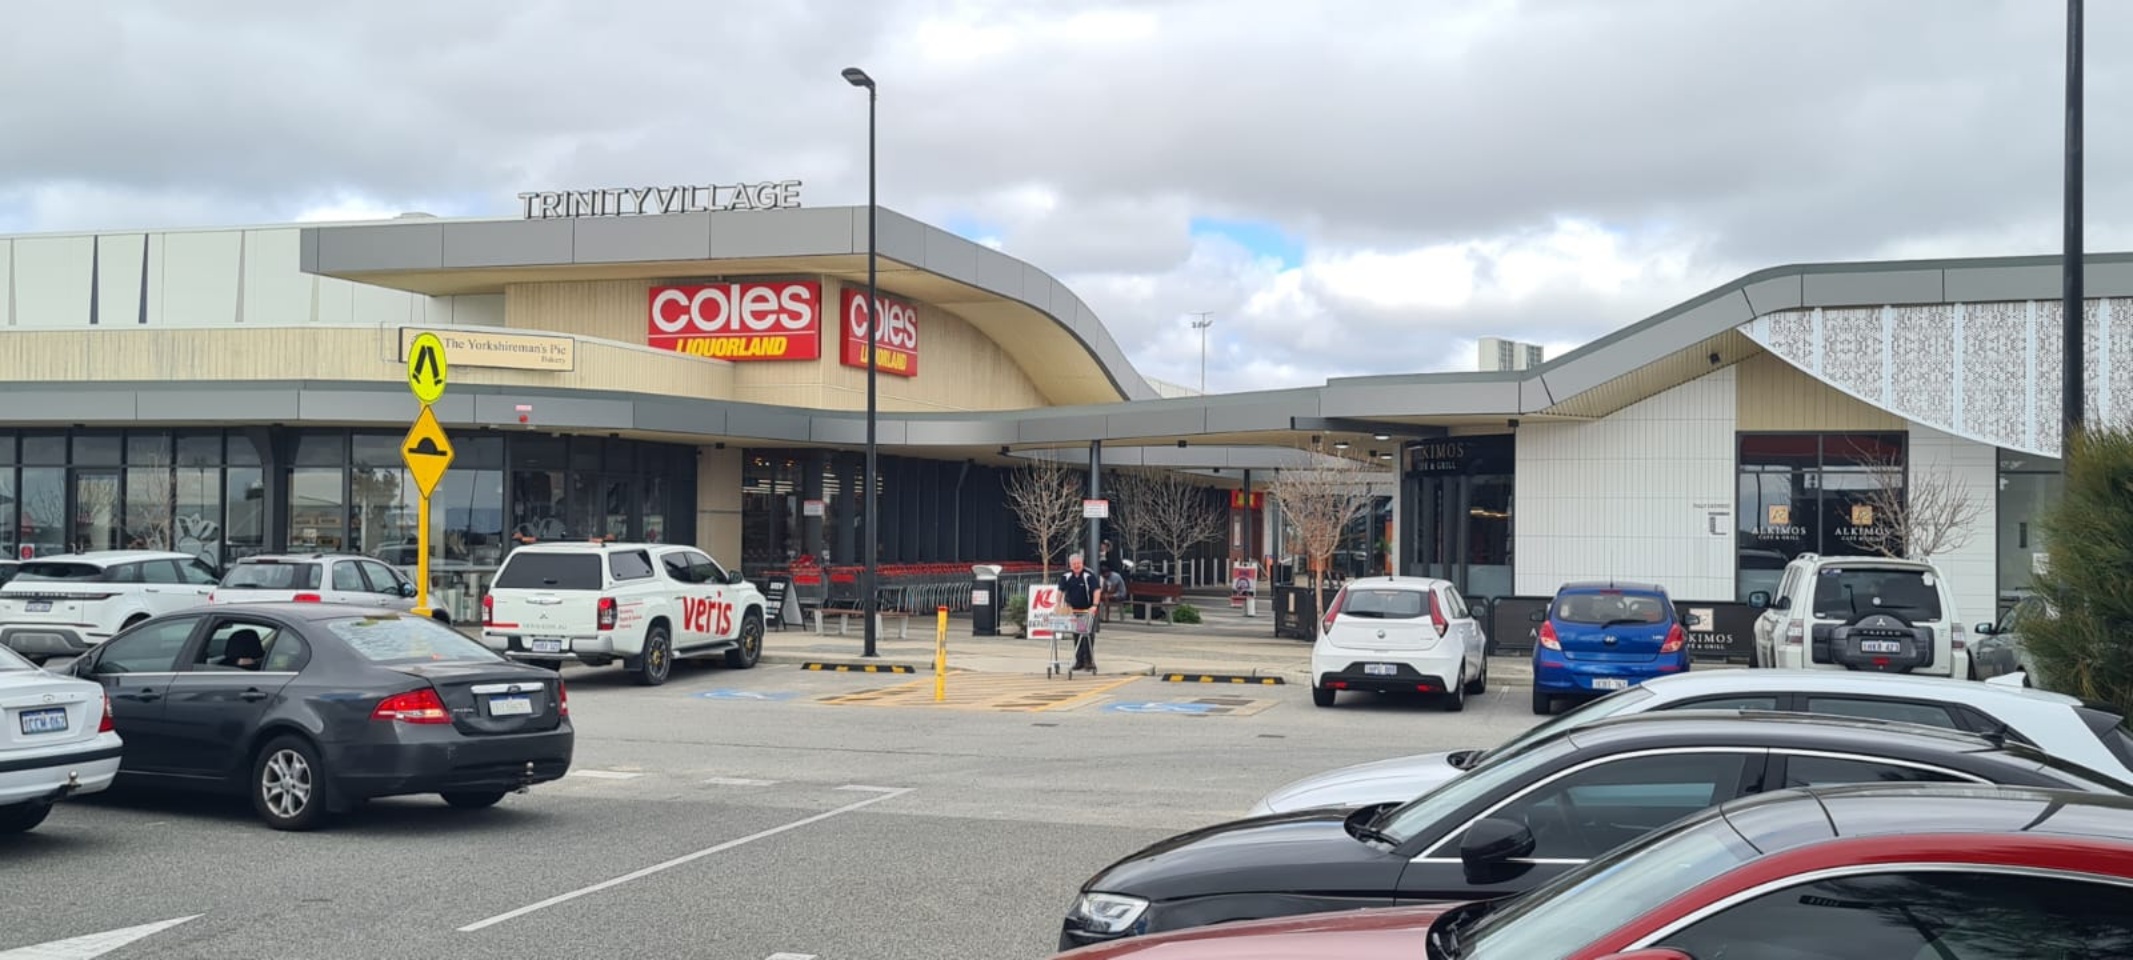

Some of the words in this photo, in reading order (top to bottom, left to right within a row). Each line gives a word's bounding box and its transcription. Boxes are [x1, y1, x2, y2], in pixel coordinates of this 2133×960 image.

[651, 284, 812, 332] coles
[850, 294, 917, 348] coles
[445, 338, 464, 349] The
[468, 338, 547, 355] Yorkshireman's
[550, 343, 566, 355] Pie
[676, 335, 788, 357] LIQUORLAND
[1751, 526, 1807, 535] ALKIMOS
[682, 590, 733, 636] veris
[1688, 633, 1734, 644] KIMOS
